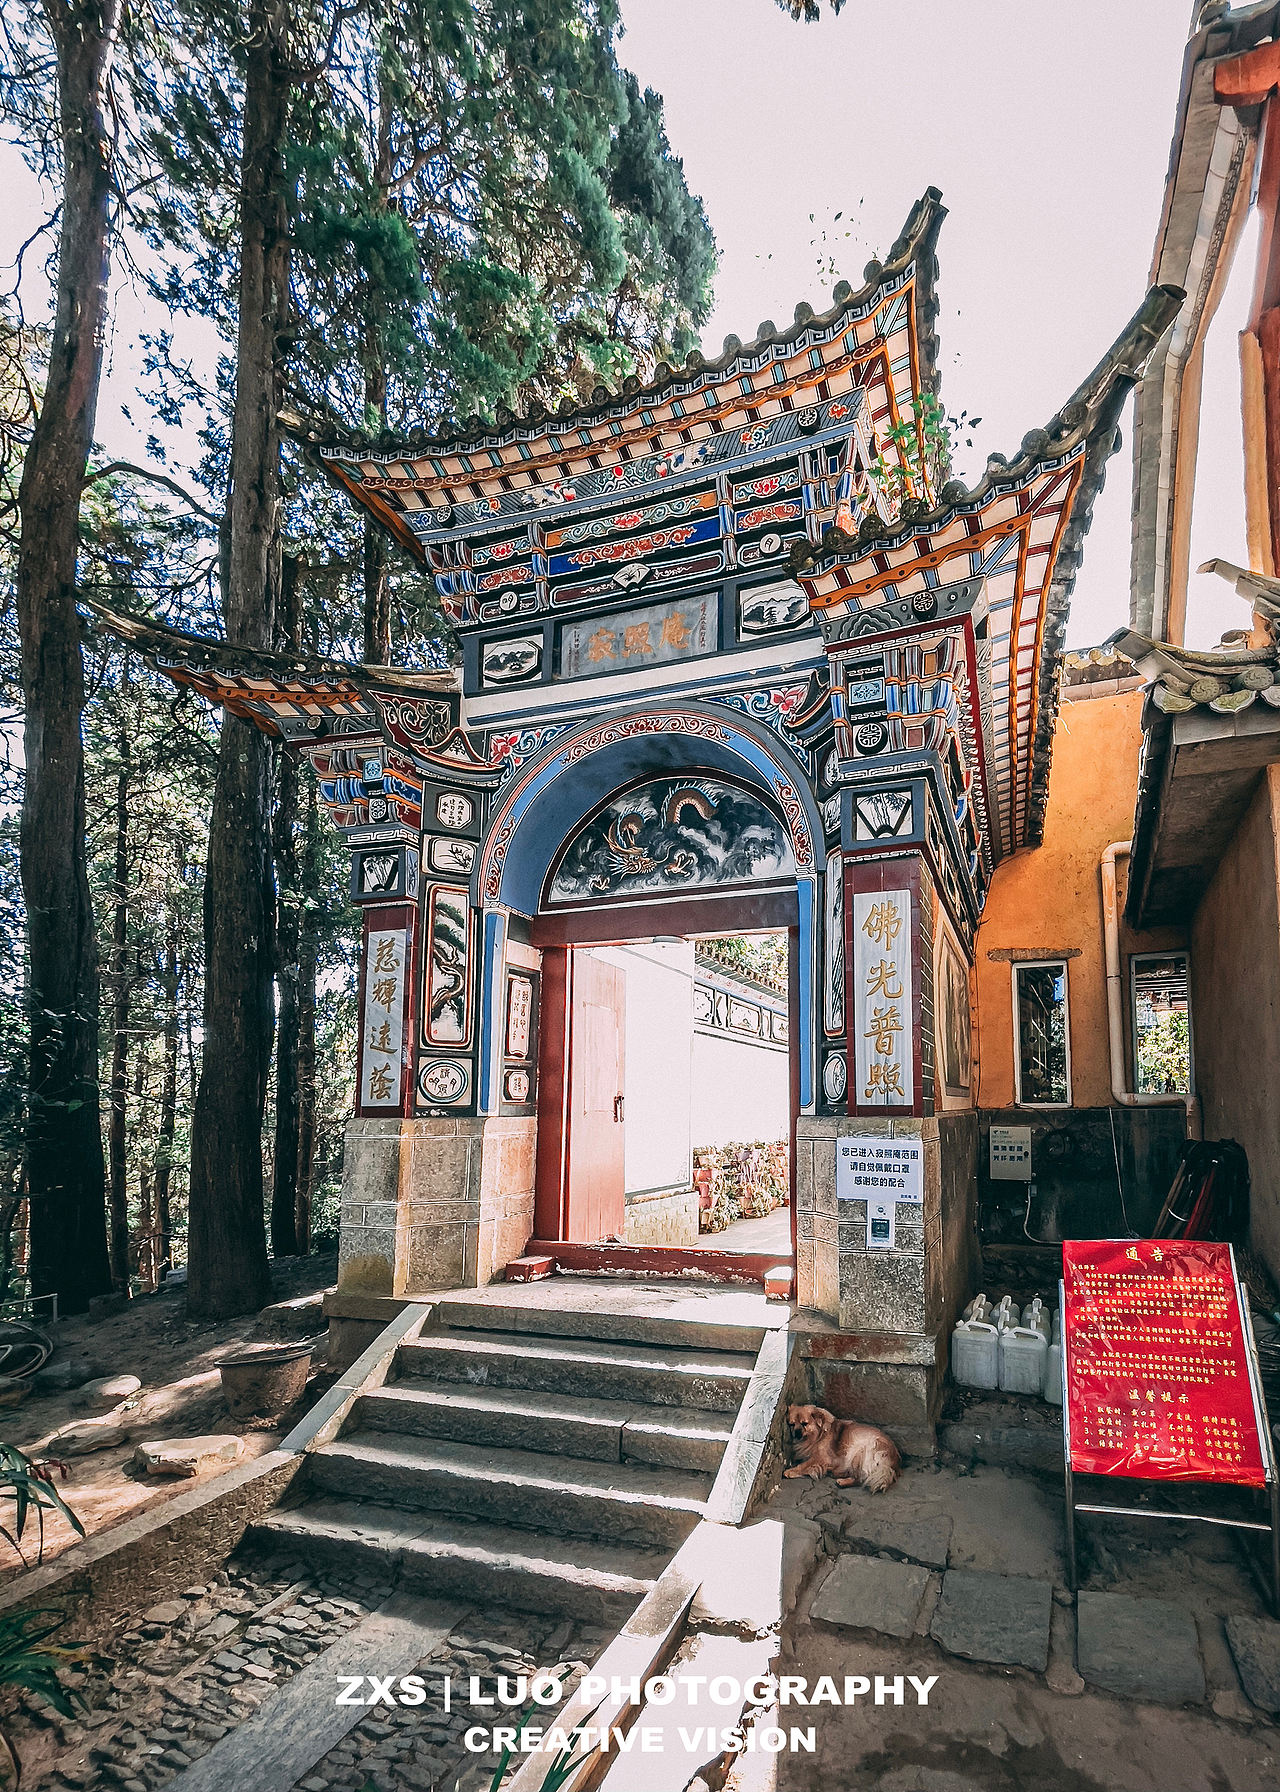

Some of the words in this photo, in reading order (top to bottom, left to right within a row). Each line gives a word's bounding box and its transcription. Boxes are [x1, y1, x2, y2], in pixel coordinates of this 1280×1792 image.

[587, 611, 691, 662] 寂照庵
[862, 900, 905, 1098] 佛光普照
[841, 1147, 919, 1160] 您已进入寂照庵范围
[850, 1162, 910, 1174] 请自觉佩戴口罩
[854, 1176, 905, 1188] 感谢您的配合
[1125, 1246, 1164, 1262] 通告
[1129, 1389, 1189, 1403] 温馨提示
